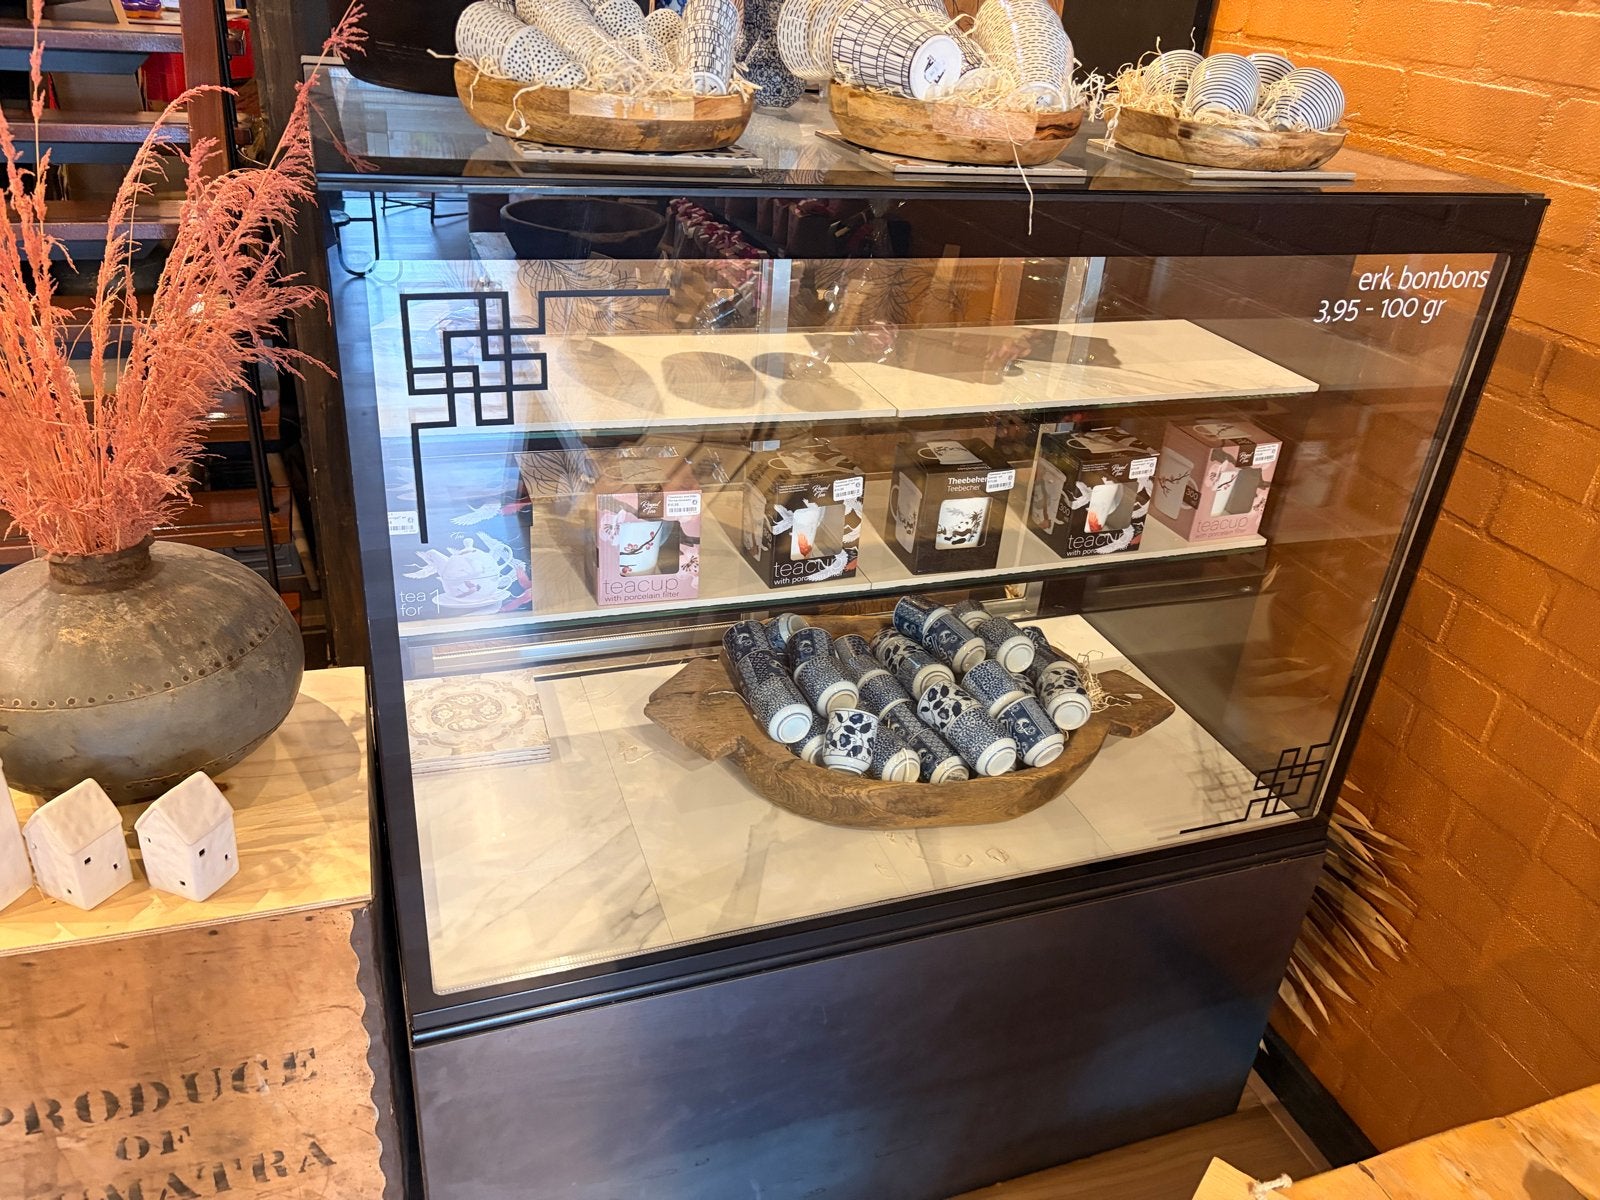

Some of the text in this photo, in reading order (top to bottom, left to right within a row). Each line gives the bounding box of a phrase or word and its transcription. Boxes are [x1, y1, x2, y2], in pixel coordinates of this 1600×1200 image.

[1358, 264, 1490, 291] erk bonbons
[1313, 299, 1361, 324] 3,95
[1381, 298, 1419, 319] 100
[1421, 299, 1447, 324] gr
[1185, 487, 1199, 501] 300
[1197, 517, 1248, 535] teacup
[1066, 549, 1081, 557] with
[603, 578, 679, 595] teacup
[774, 576, 791, 585] with
[400, 591, 426, 603] tea
[400, 588, 440, 617] for 1
[624, 593, 660, 601] porcelain
[115, 1125, 191, 1161] OF
[55, 1140, 337, 1200] MATRA
